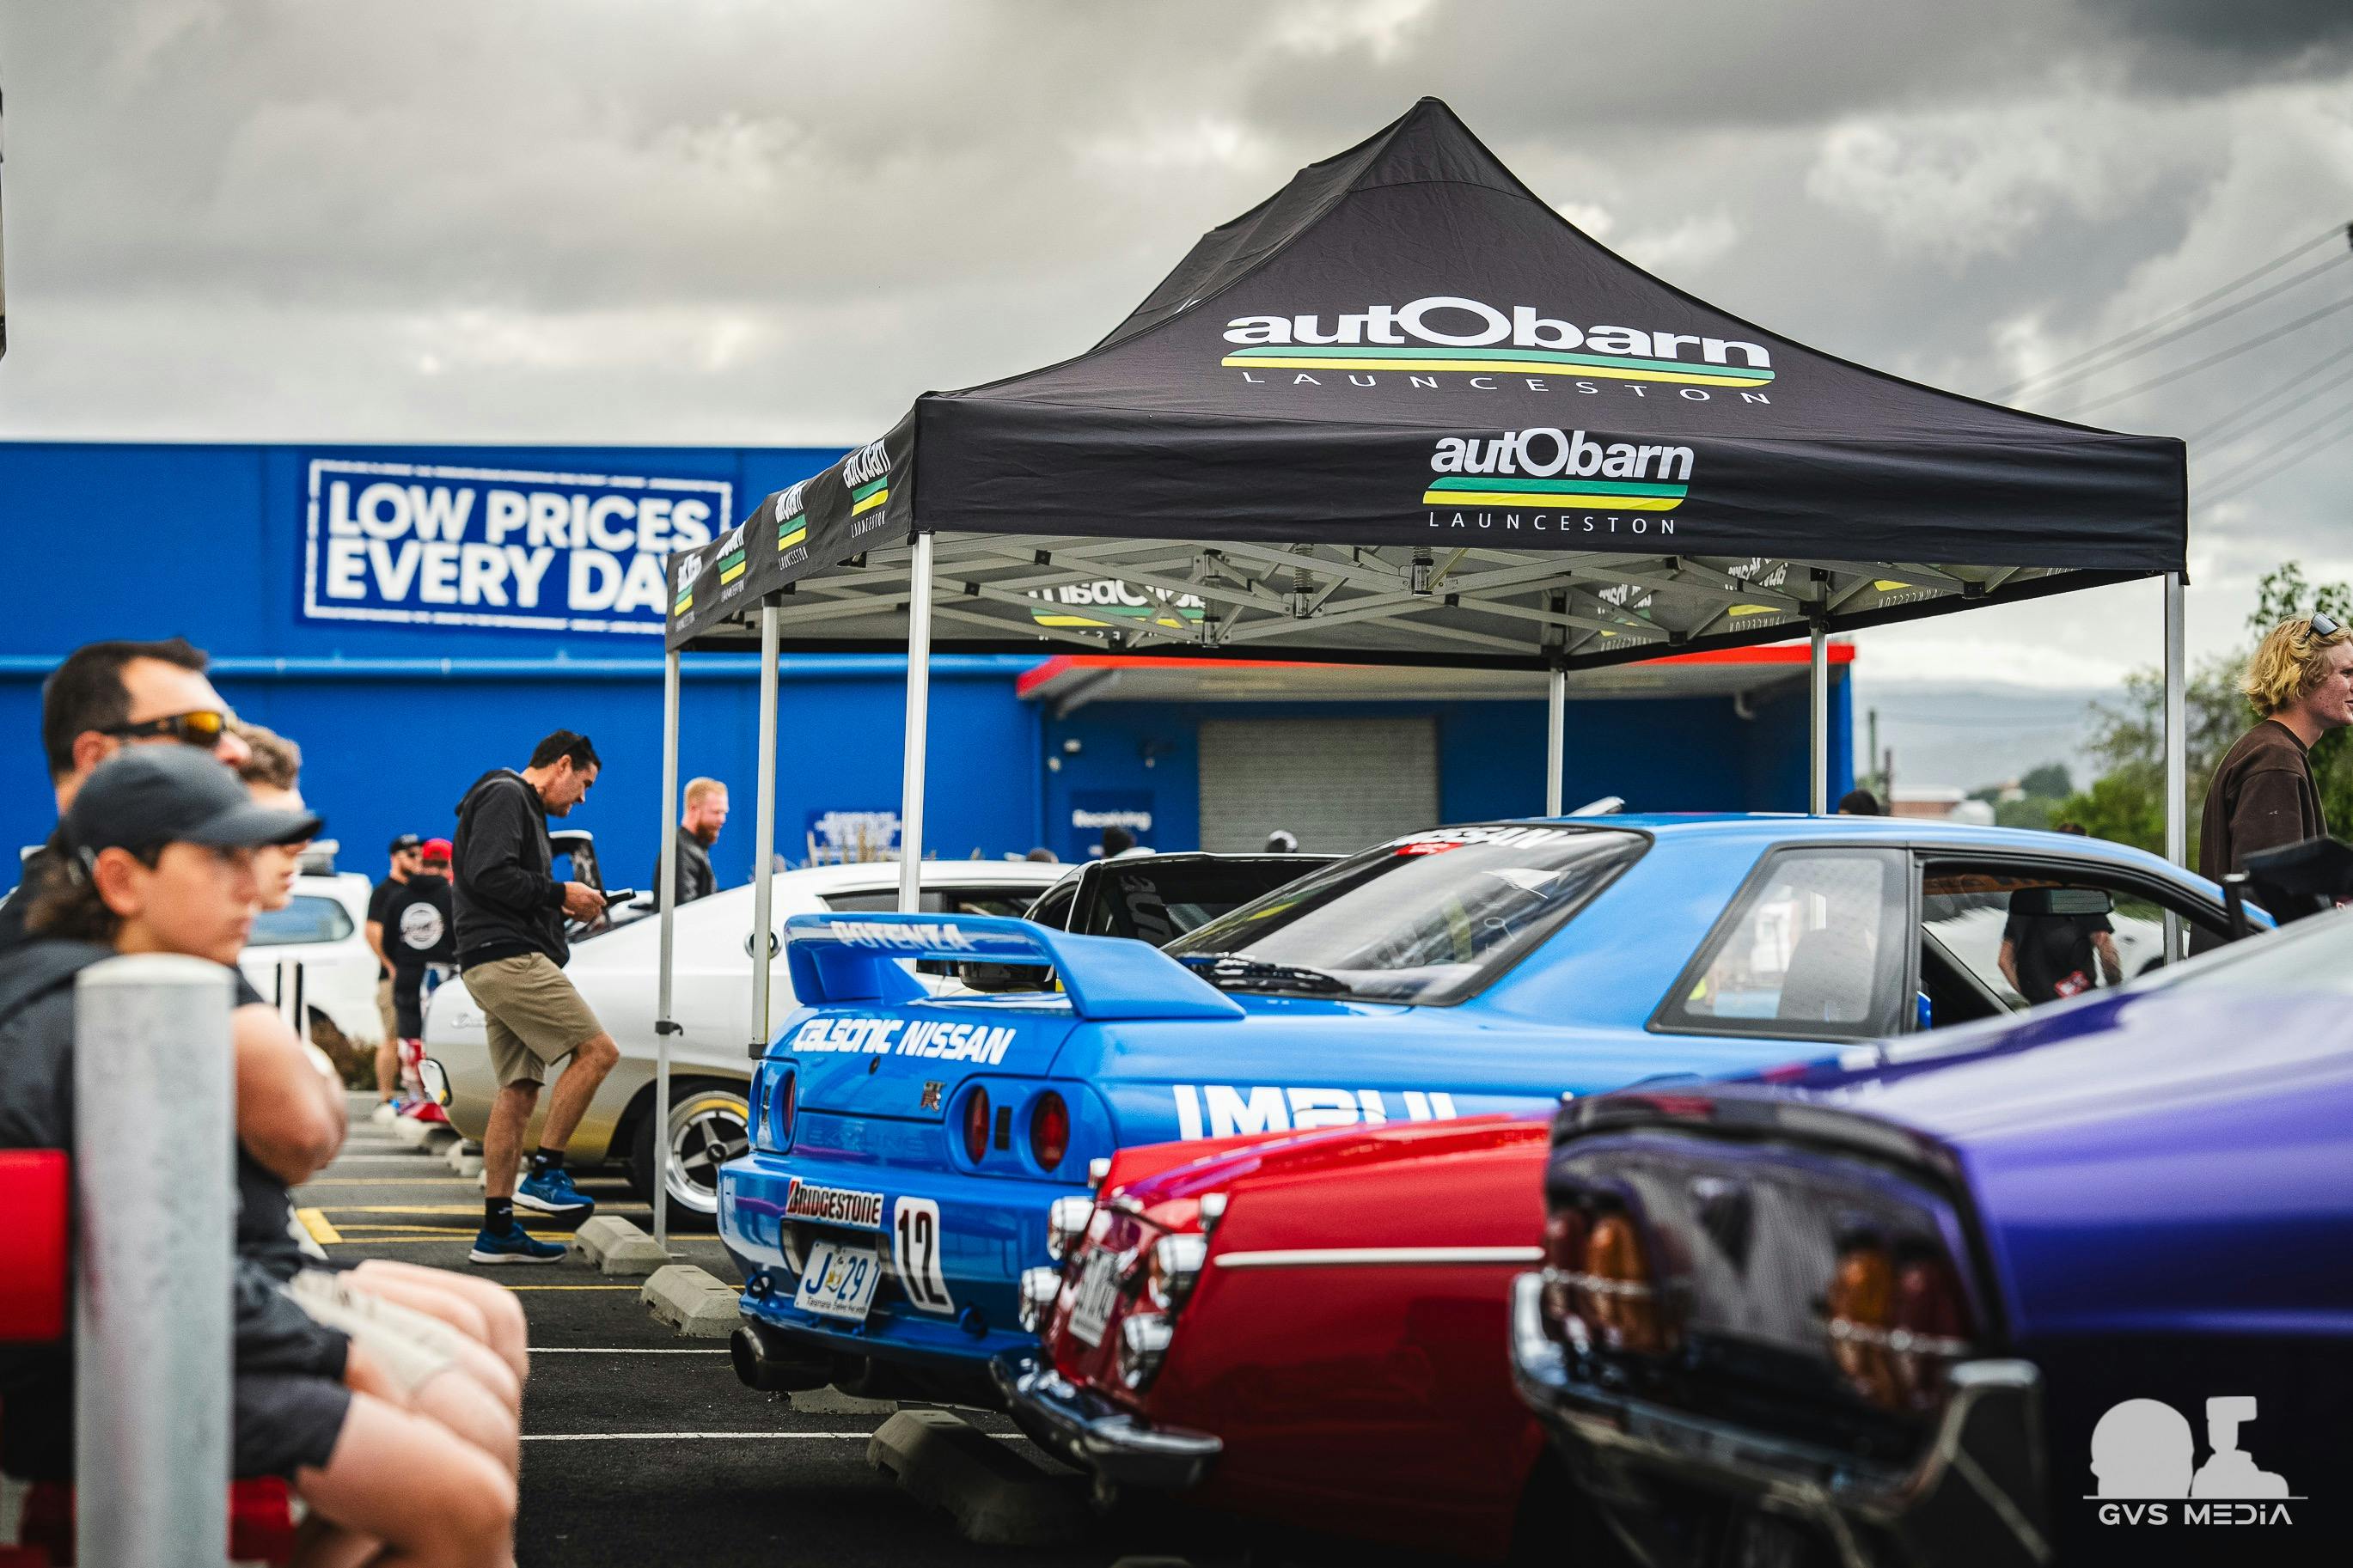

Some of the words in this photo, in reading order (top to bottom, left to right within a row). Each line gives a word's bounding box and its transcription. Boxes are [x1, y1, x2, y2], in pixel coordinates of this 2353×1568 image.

[1242, 371, 1772, 405] LAUNCESTON
[328, 480, 476, 542] LOW
[486, 489, 712, 553] PRICES
[1428, 511, 1675, 534] LAUNCESTON
[326, 537, 555, 608] EVERY
[567, 548, 669, 614] DA
[895, 1020, 1017, 1066] NISSAN
[786, 1180, 882, 1225] BRIDGESTONE
[898, 1209, 949, 1305] 12
